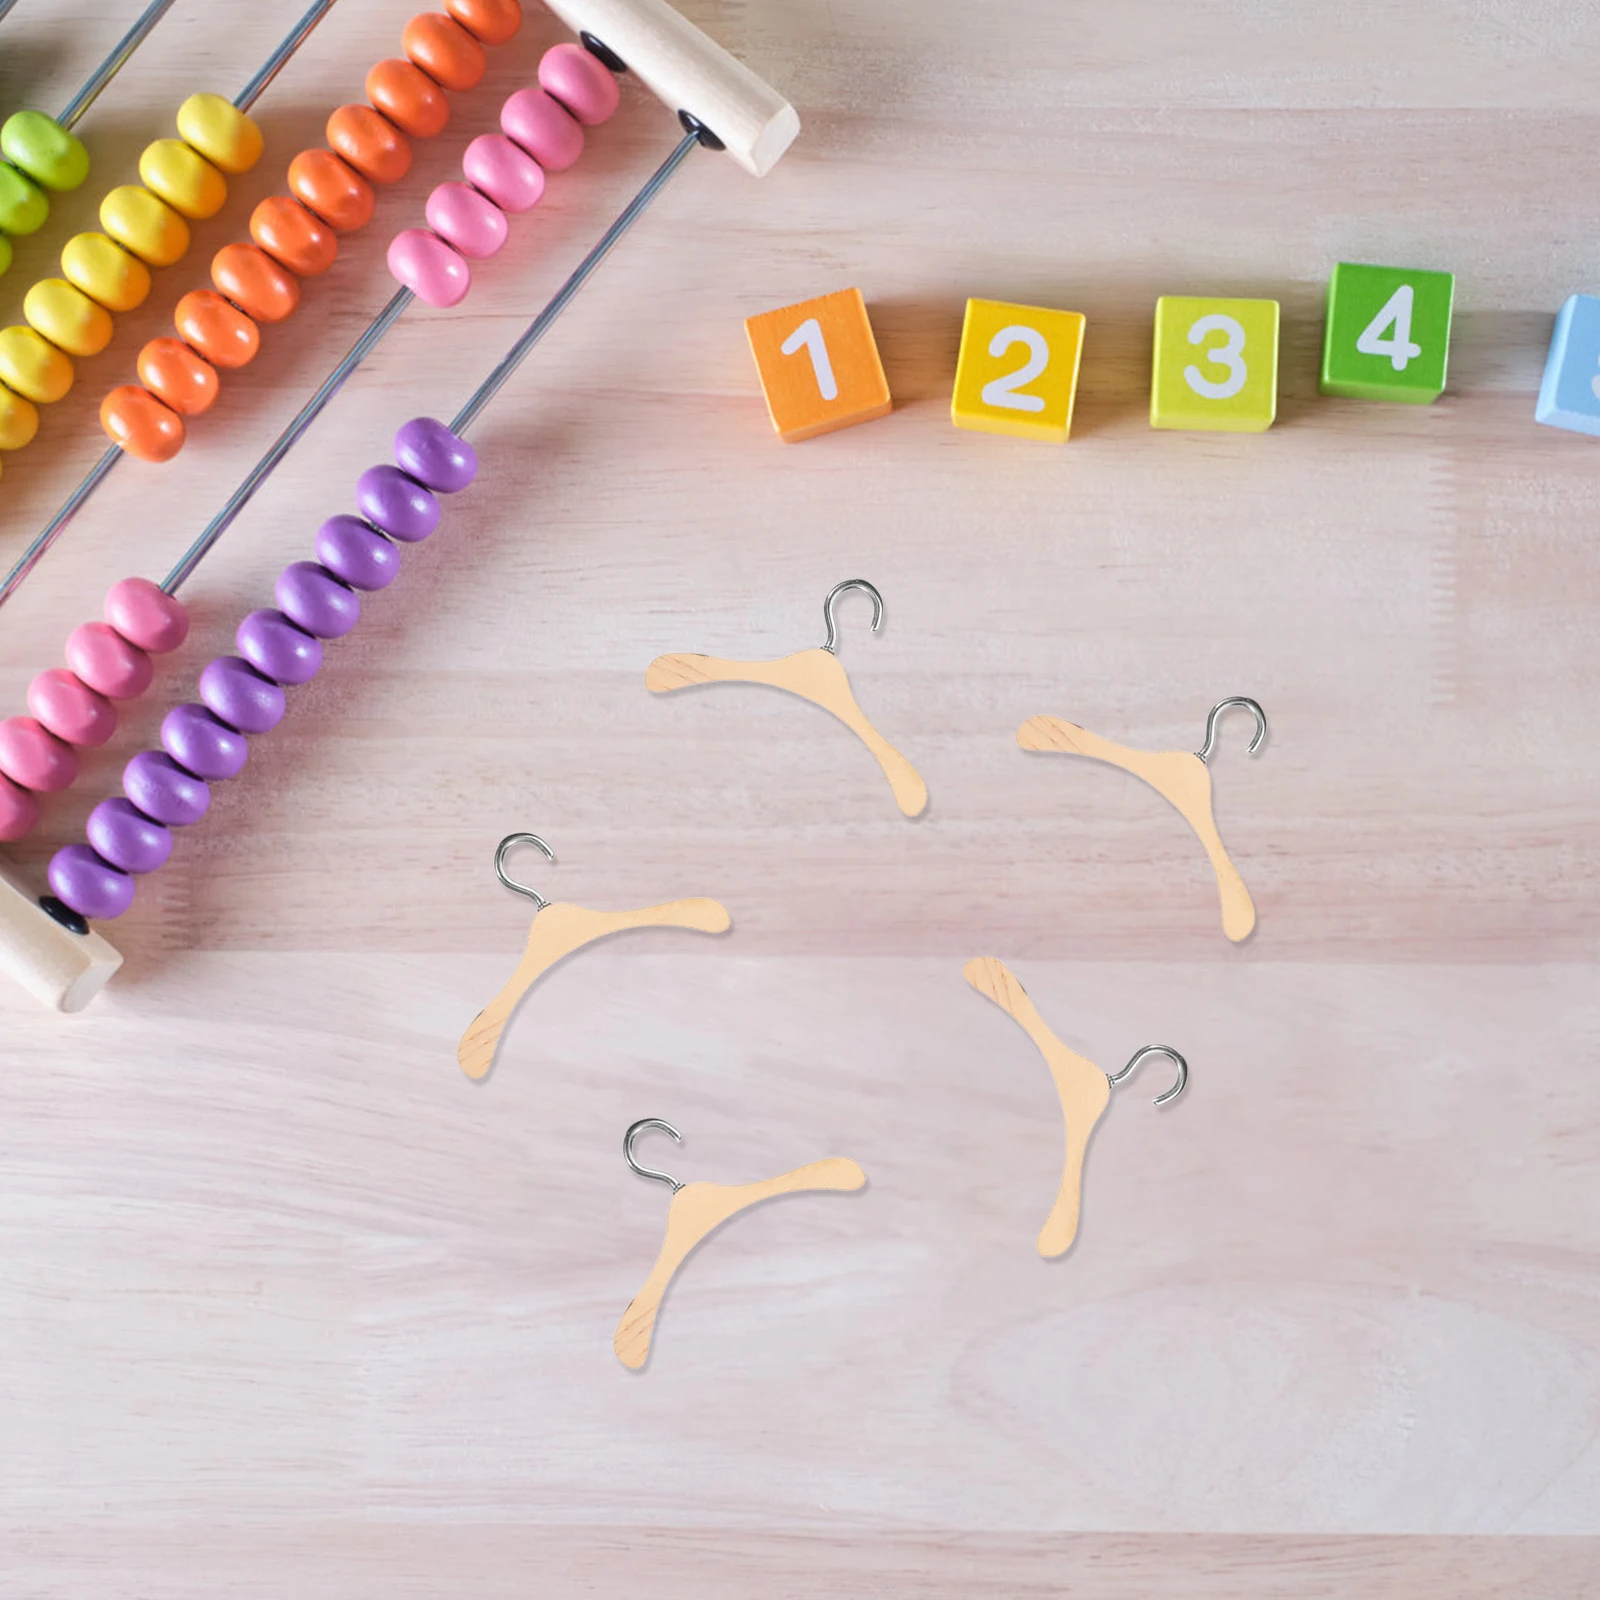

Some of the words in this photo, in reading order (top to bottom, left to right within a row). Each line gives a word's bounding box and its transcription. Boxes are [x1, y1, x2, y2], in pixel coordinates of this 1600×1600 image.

[781, 318, 838, 401] 1
[981, 326, 1050, 413] 2
[1183, 314, 1248, 399] 3
[1356, 285, 1421, 371] 4
